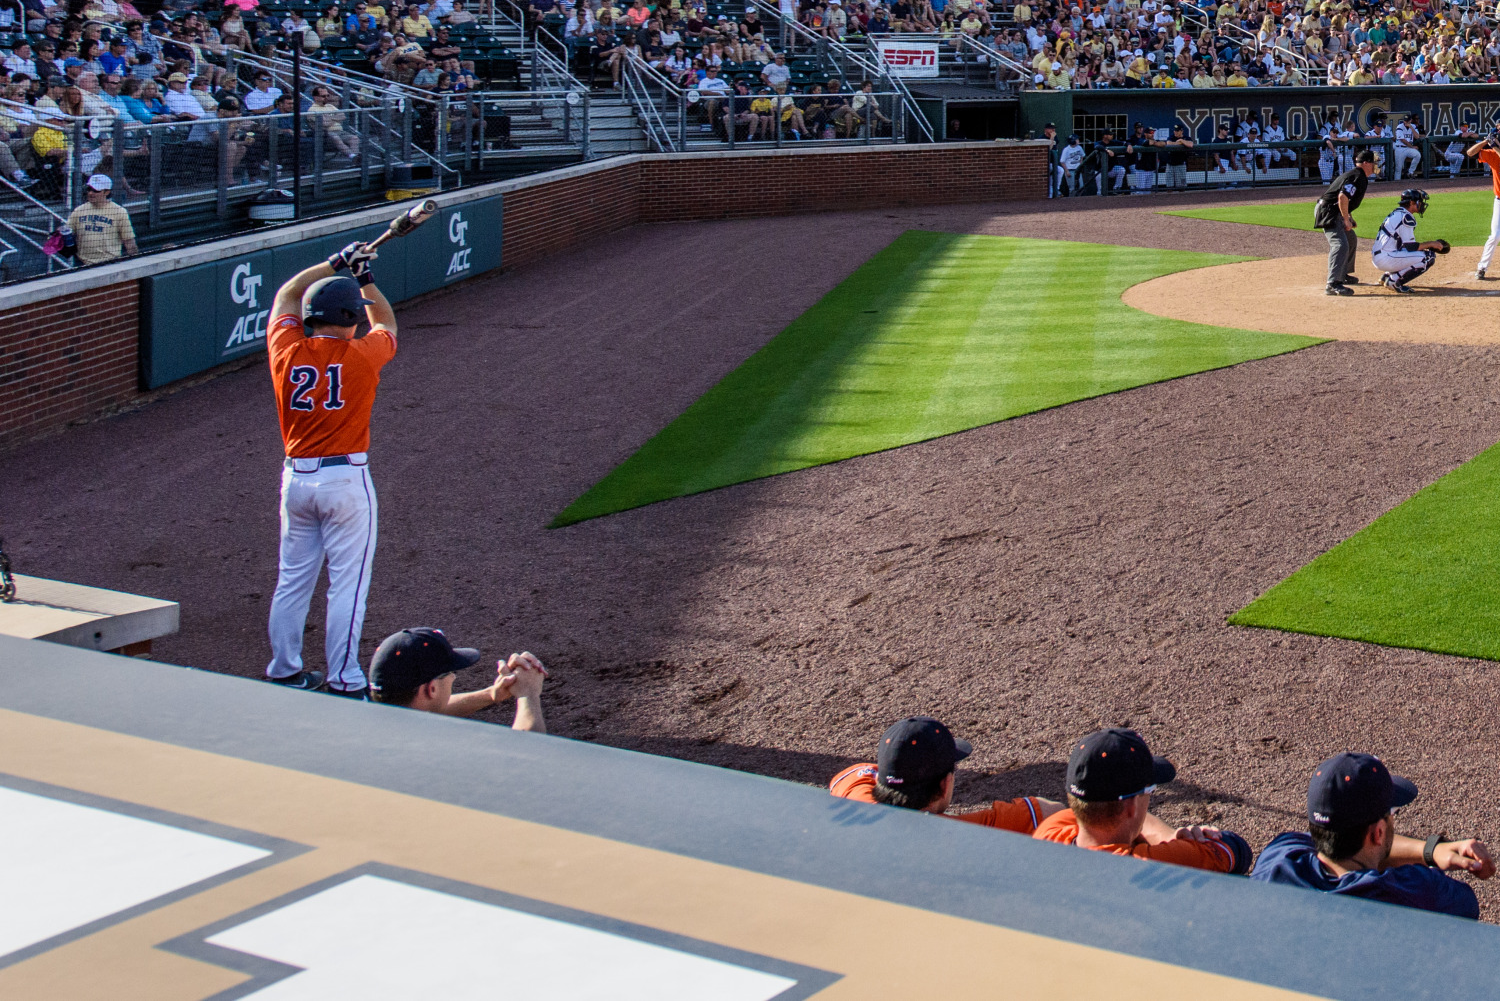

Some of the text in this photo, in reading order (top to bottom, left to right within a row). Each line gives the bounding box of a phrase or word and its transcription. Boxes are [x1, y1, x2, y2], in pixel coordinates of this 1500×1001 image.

[883, 49, 936, 65] ESPN
[449, 212, 468, 247] GT
[446, 248, 472, 276] ACC
[230, 262, 262, 308] GT
[225, 310, 269, 348] ACC
[290, 364, 345, 412] 21
